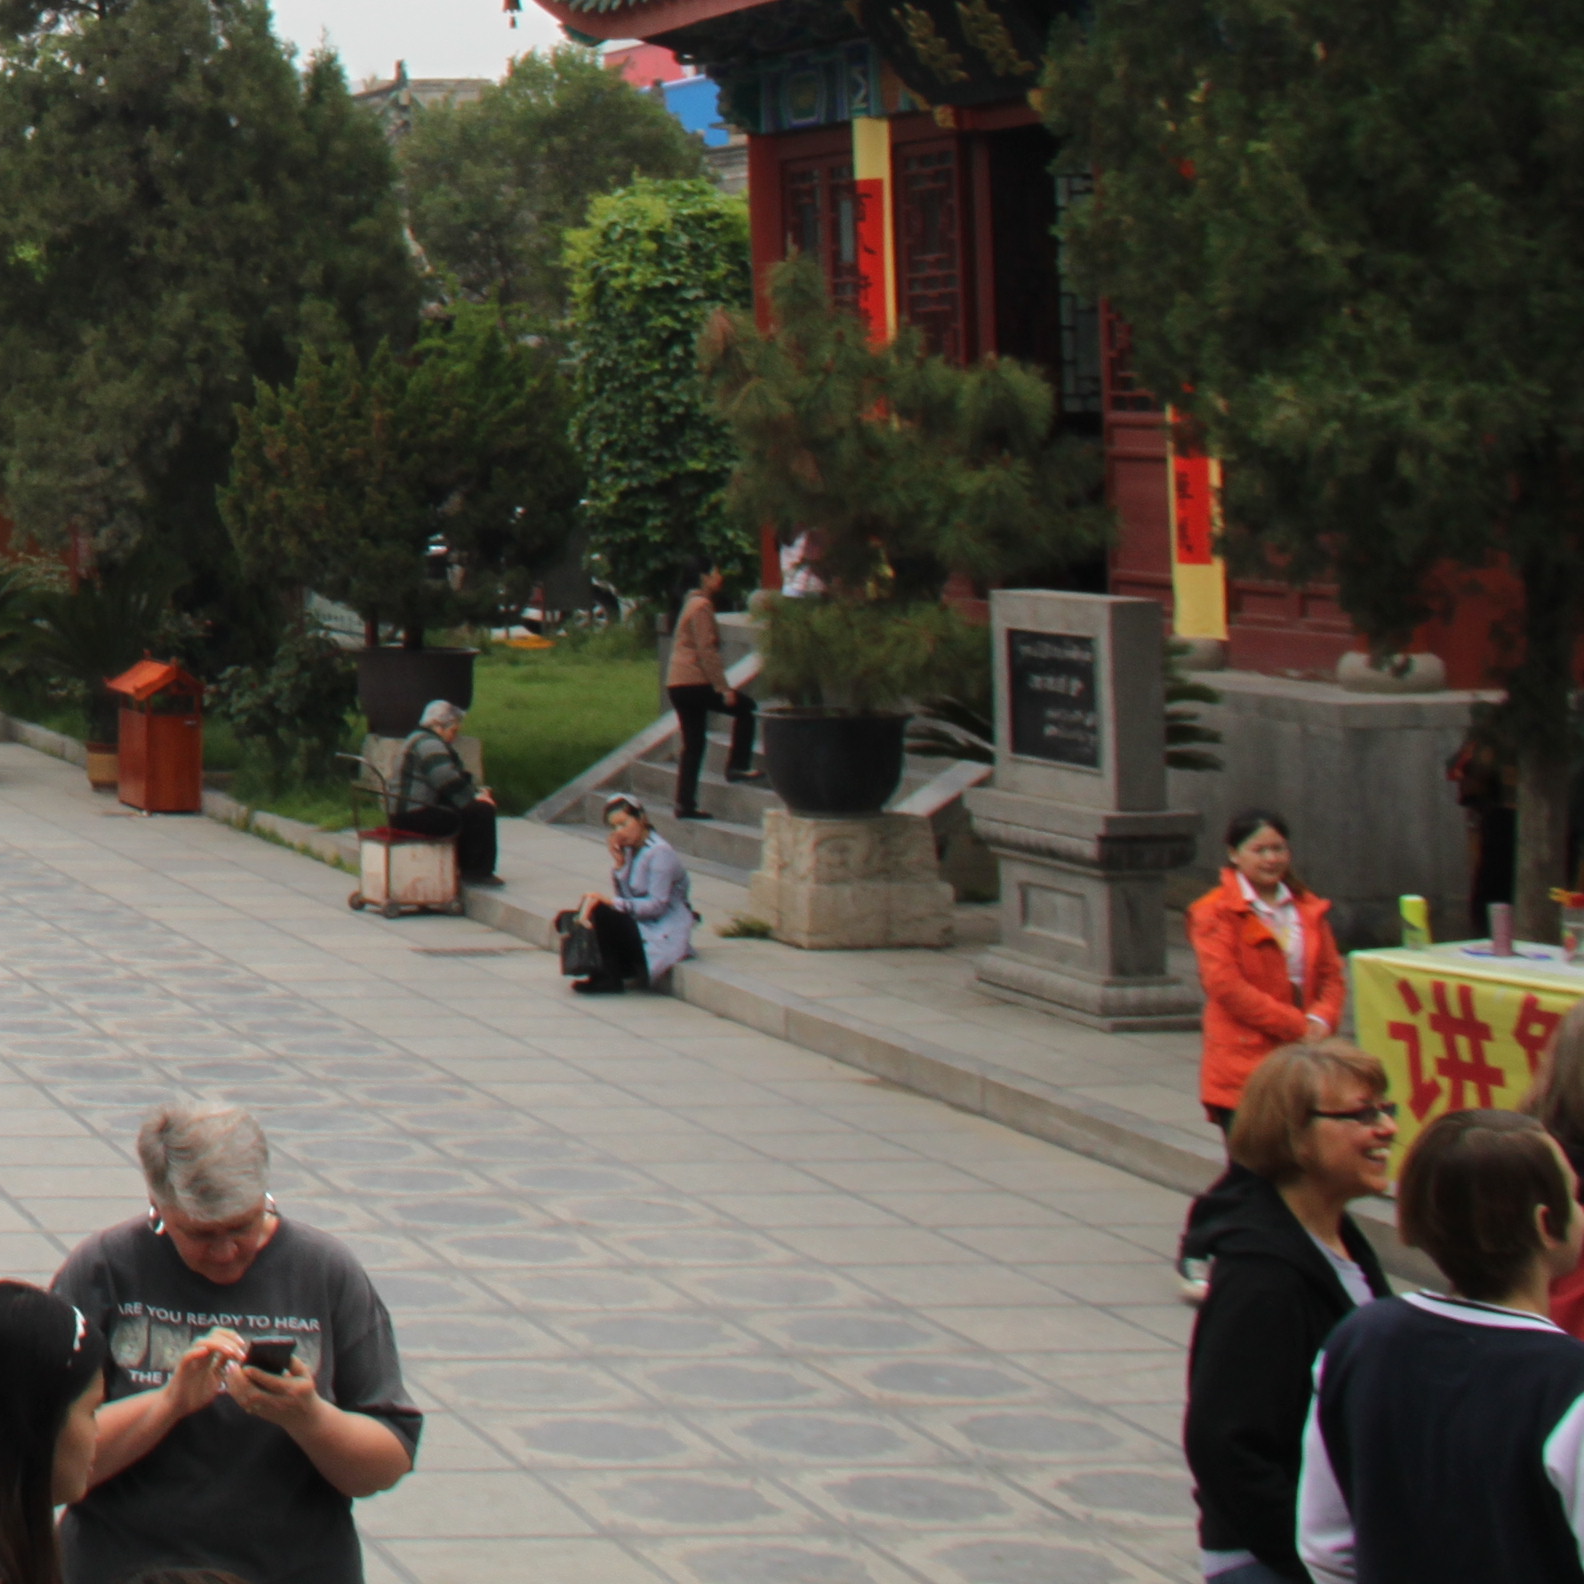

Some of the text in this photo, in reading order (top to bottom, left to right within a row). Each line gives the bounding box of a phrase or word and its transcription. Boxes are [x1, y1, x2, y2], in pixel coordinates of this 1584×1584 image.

[1387, 977, 1563, 1124] 讲
[145, 1304, 182, 1324] YOU
[186, 1311, 241, 1328] READY
[245, 1314, 270, 1329] TO
[273, 1316, 321, 1332] HEAR
[127, 1369, 163, 1386] THE
